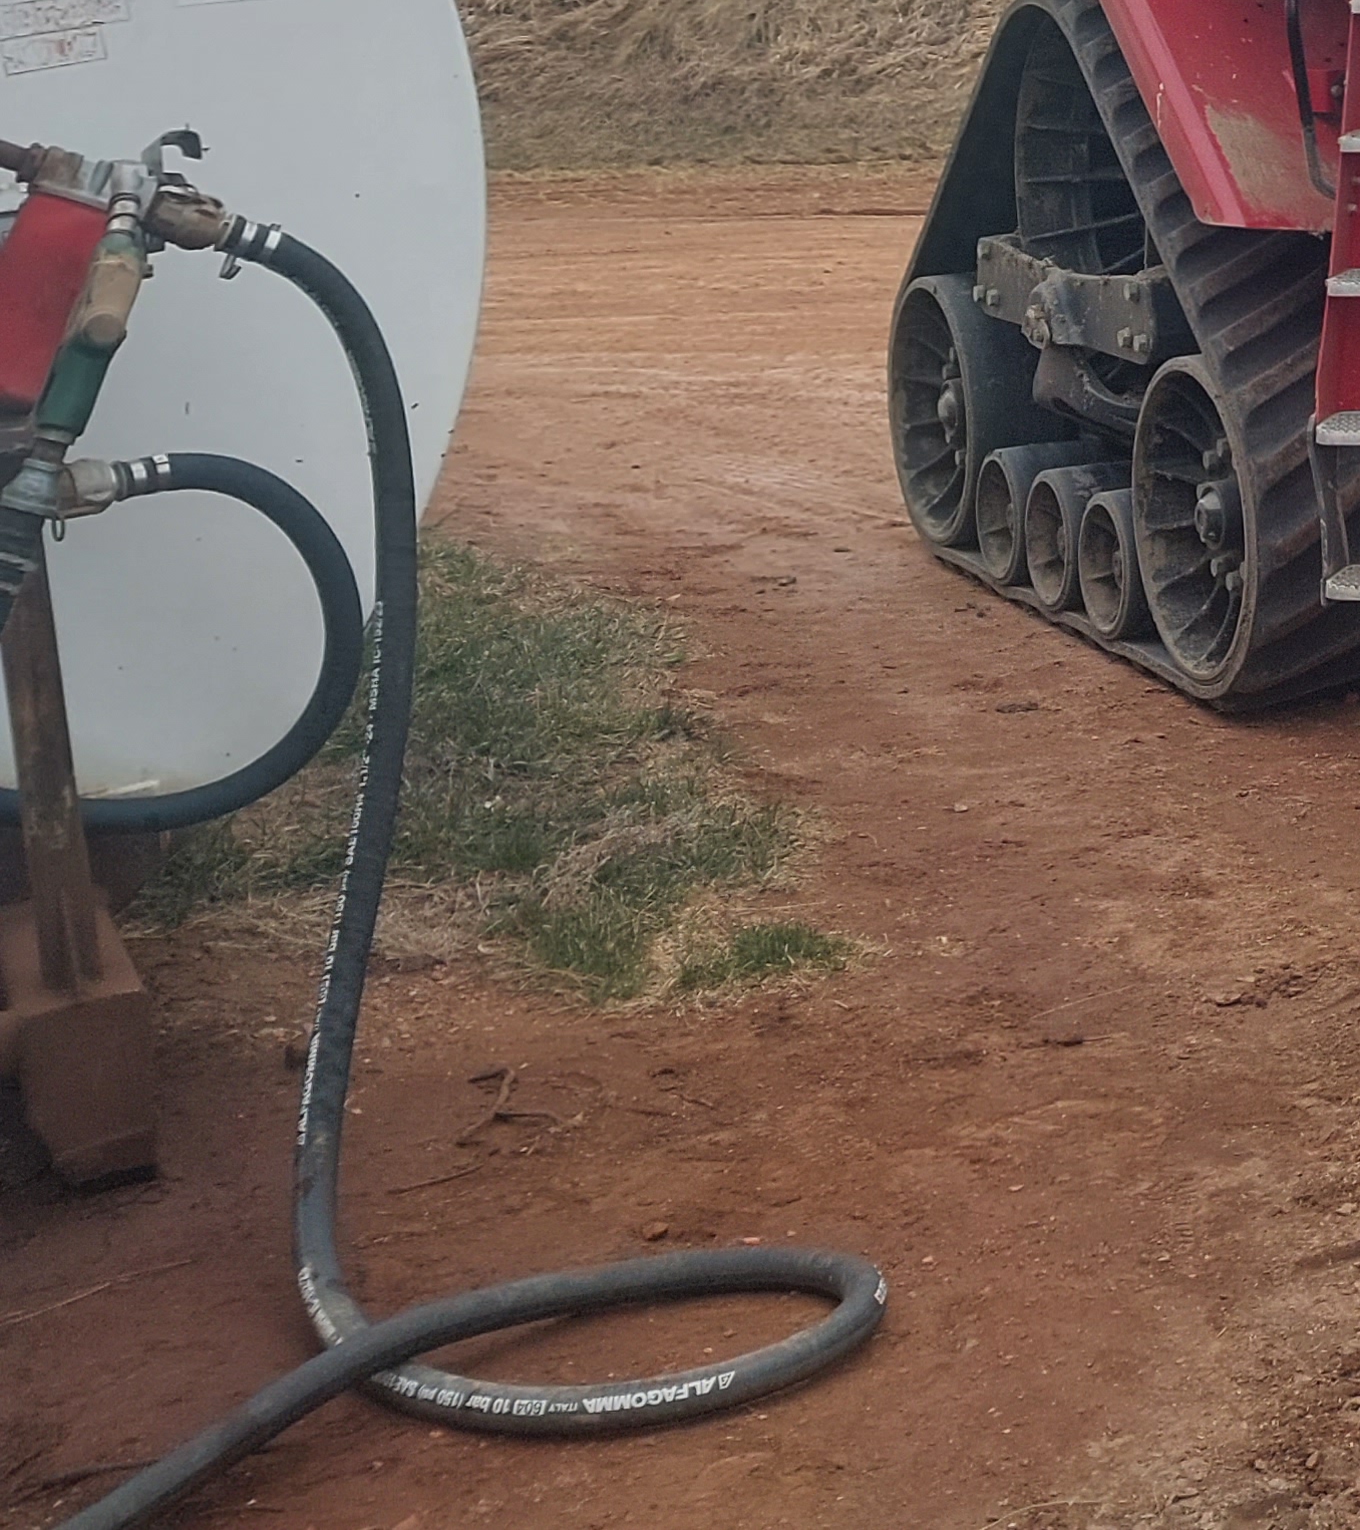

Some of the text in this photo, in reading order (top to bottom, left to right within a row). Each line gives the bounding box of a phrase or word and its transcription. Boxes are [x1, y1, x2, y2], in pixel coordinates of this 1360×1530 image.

[436, 1389, 464, 1409] (150
[465, 1395, 492, 1413] bar
[582, 1376, 717, 1414] ALFAGOMMA
[492, 1398, 511, 1414] 10
[548, 1402, 578, 1413] ITALY
